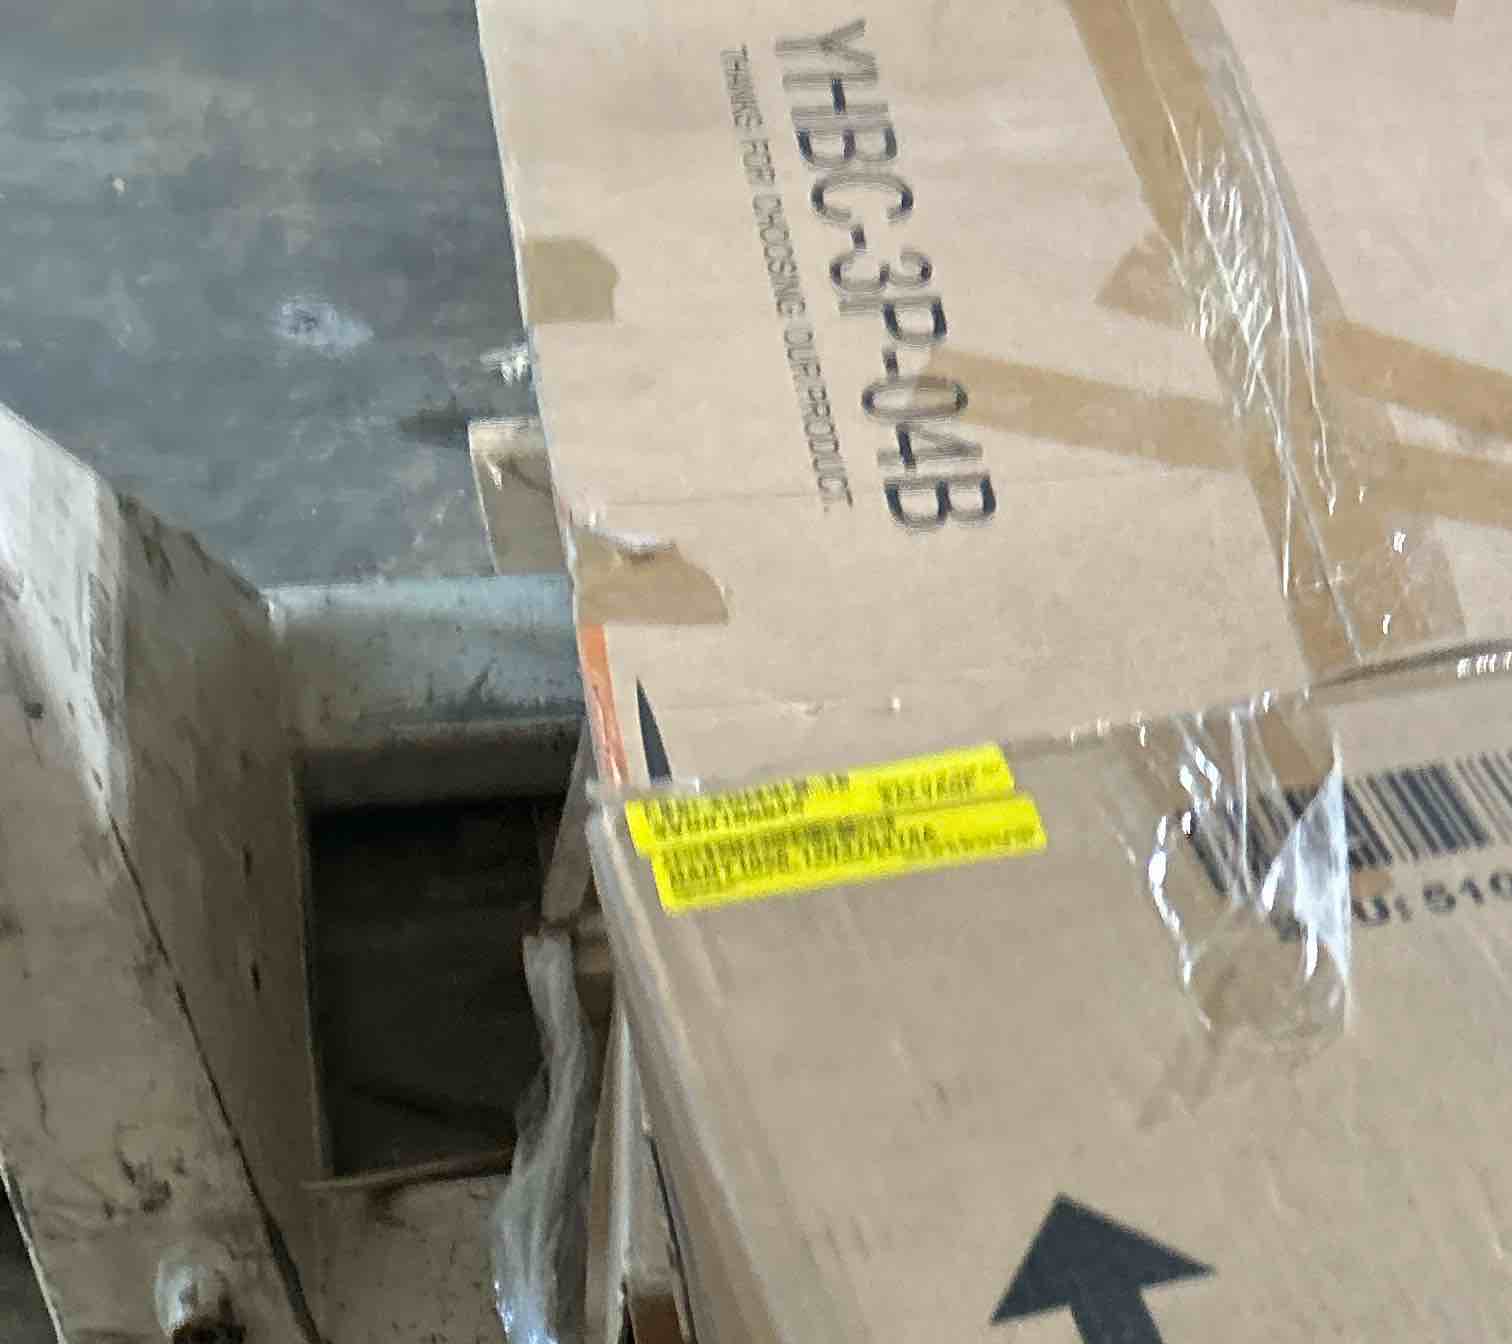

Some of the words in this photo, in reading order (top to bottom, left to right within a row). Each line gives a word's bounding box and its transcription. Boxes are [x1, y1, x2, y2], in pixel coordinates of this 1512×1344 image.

[741, 137, 776, 186] FOR
[752, 193, 806, 319] CHOOSING
[774, 18, 997, 532] YHBC-3P-04B
[784, 326, 822, 393] OUR
